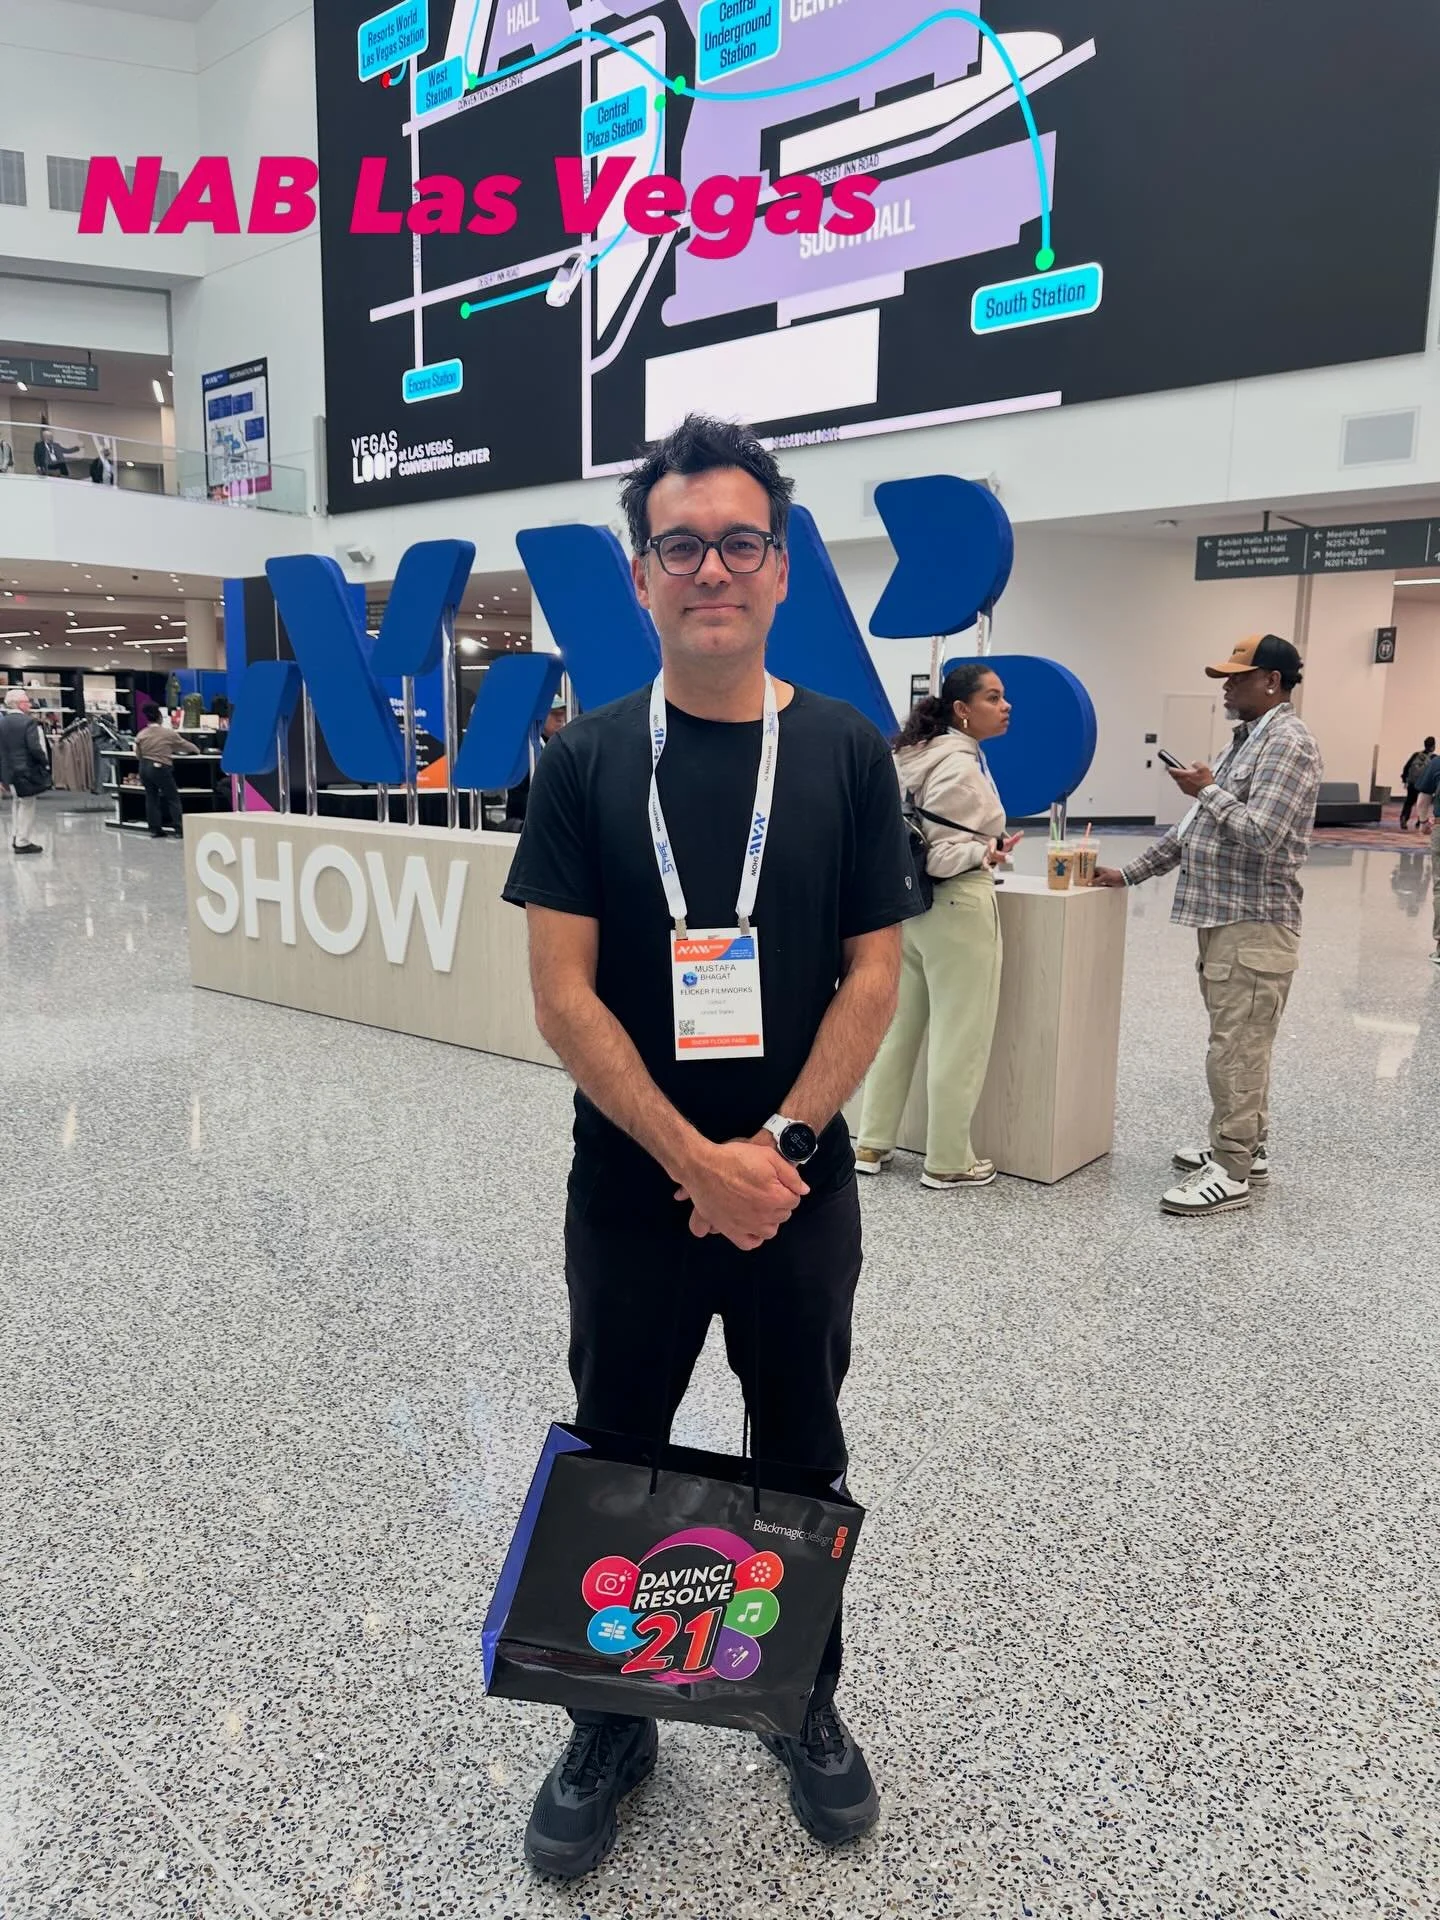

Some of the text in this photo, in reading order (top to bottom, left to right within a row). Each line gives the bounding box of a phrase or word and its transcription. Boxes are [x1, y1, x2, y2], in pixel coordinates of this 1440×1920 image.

[367, 8, 418, 47] Resorts World
[506, 1, 541, 36] HALL
[704, 6, 772, 51] Underground
[361, 27, 425, 69] Las Vegas Station
[720, 42, 757, 68] Station
[427, 66, 448, 88] West
[425, 86, 453, 109] Station
[597, 96, 630, 125] Central
[586, 117, 644, 150] Plaza Station
[986, 282, 1086, 319] South Station
[432, 371, 458, 388] Station
[351, 430, 398, 458] VEGAS
[398, 438, 454, 462] at LAS VEGAS
[352, 450, 398, 484] LOOP
[398, 447, 491, 477] CONVENTION CENTER
[1217, 538, 1243, 548] Exhibit
[1243, 536, 1263, 546] Halls
[1326, 526, 1387, 539] Meeting Rooms
[1216, 548, 1241, 558] Bridge
[1269, 544, 1286, 553] Hall
[1216, 559, 1246, 569] Skywalk
[1325, 547, 1385, 559] Meeting Rooms
[750, 855, 760, 877] SHOW
[195, 831, 470, 973] SHOW
[694, 963, 737, 973] MUSTAFA
[700, 972, 731, 981] BHAGAT
[680, 986, 753, 996] FLICKER FILMWORKS
[752, 1518, 834, 1547] Blackmagicdesign
[639, 1563, 733, 1590] DAVINCI
[633, 1582, 734, 1610] RESOLVE
[620, 1606, 723, 1674] 21
